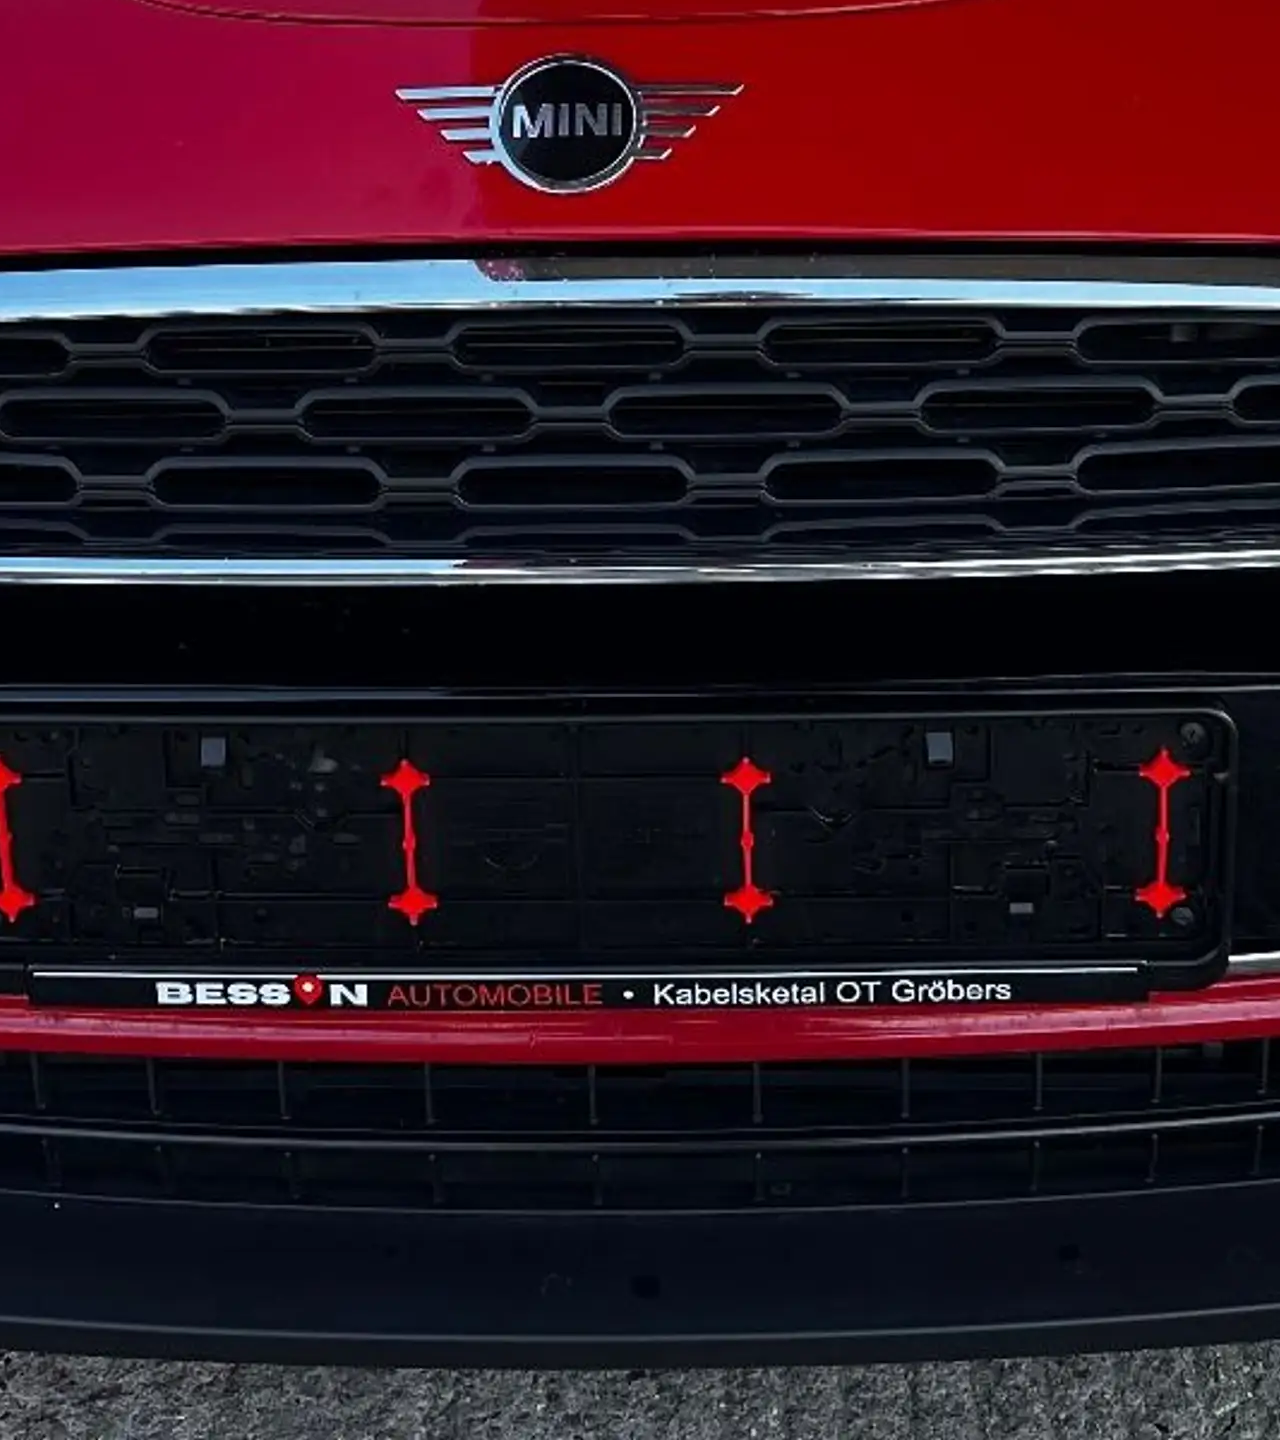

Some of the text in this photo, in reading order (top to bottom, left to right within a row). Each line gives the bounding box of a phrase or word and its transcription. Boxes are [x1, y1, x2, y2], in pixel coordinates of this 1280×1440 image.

[511, 102, 623, 139] MINI
[388, 984, 604, 1006] AUTOMOBILE
[653, 982, 826, 1006] Kabelsketal
[836, 980, 881, 1004] OT
[891, 979, 1012, 1004] Gröbers
